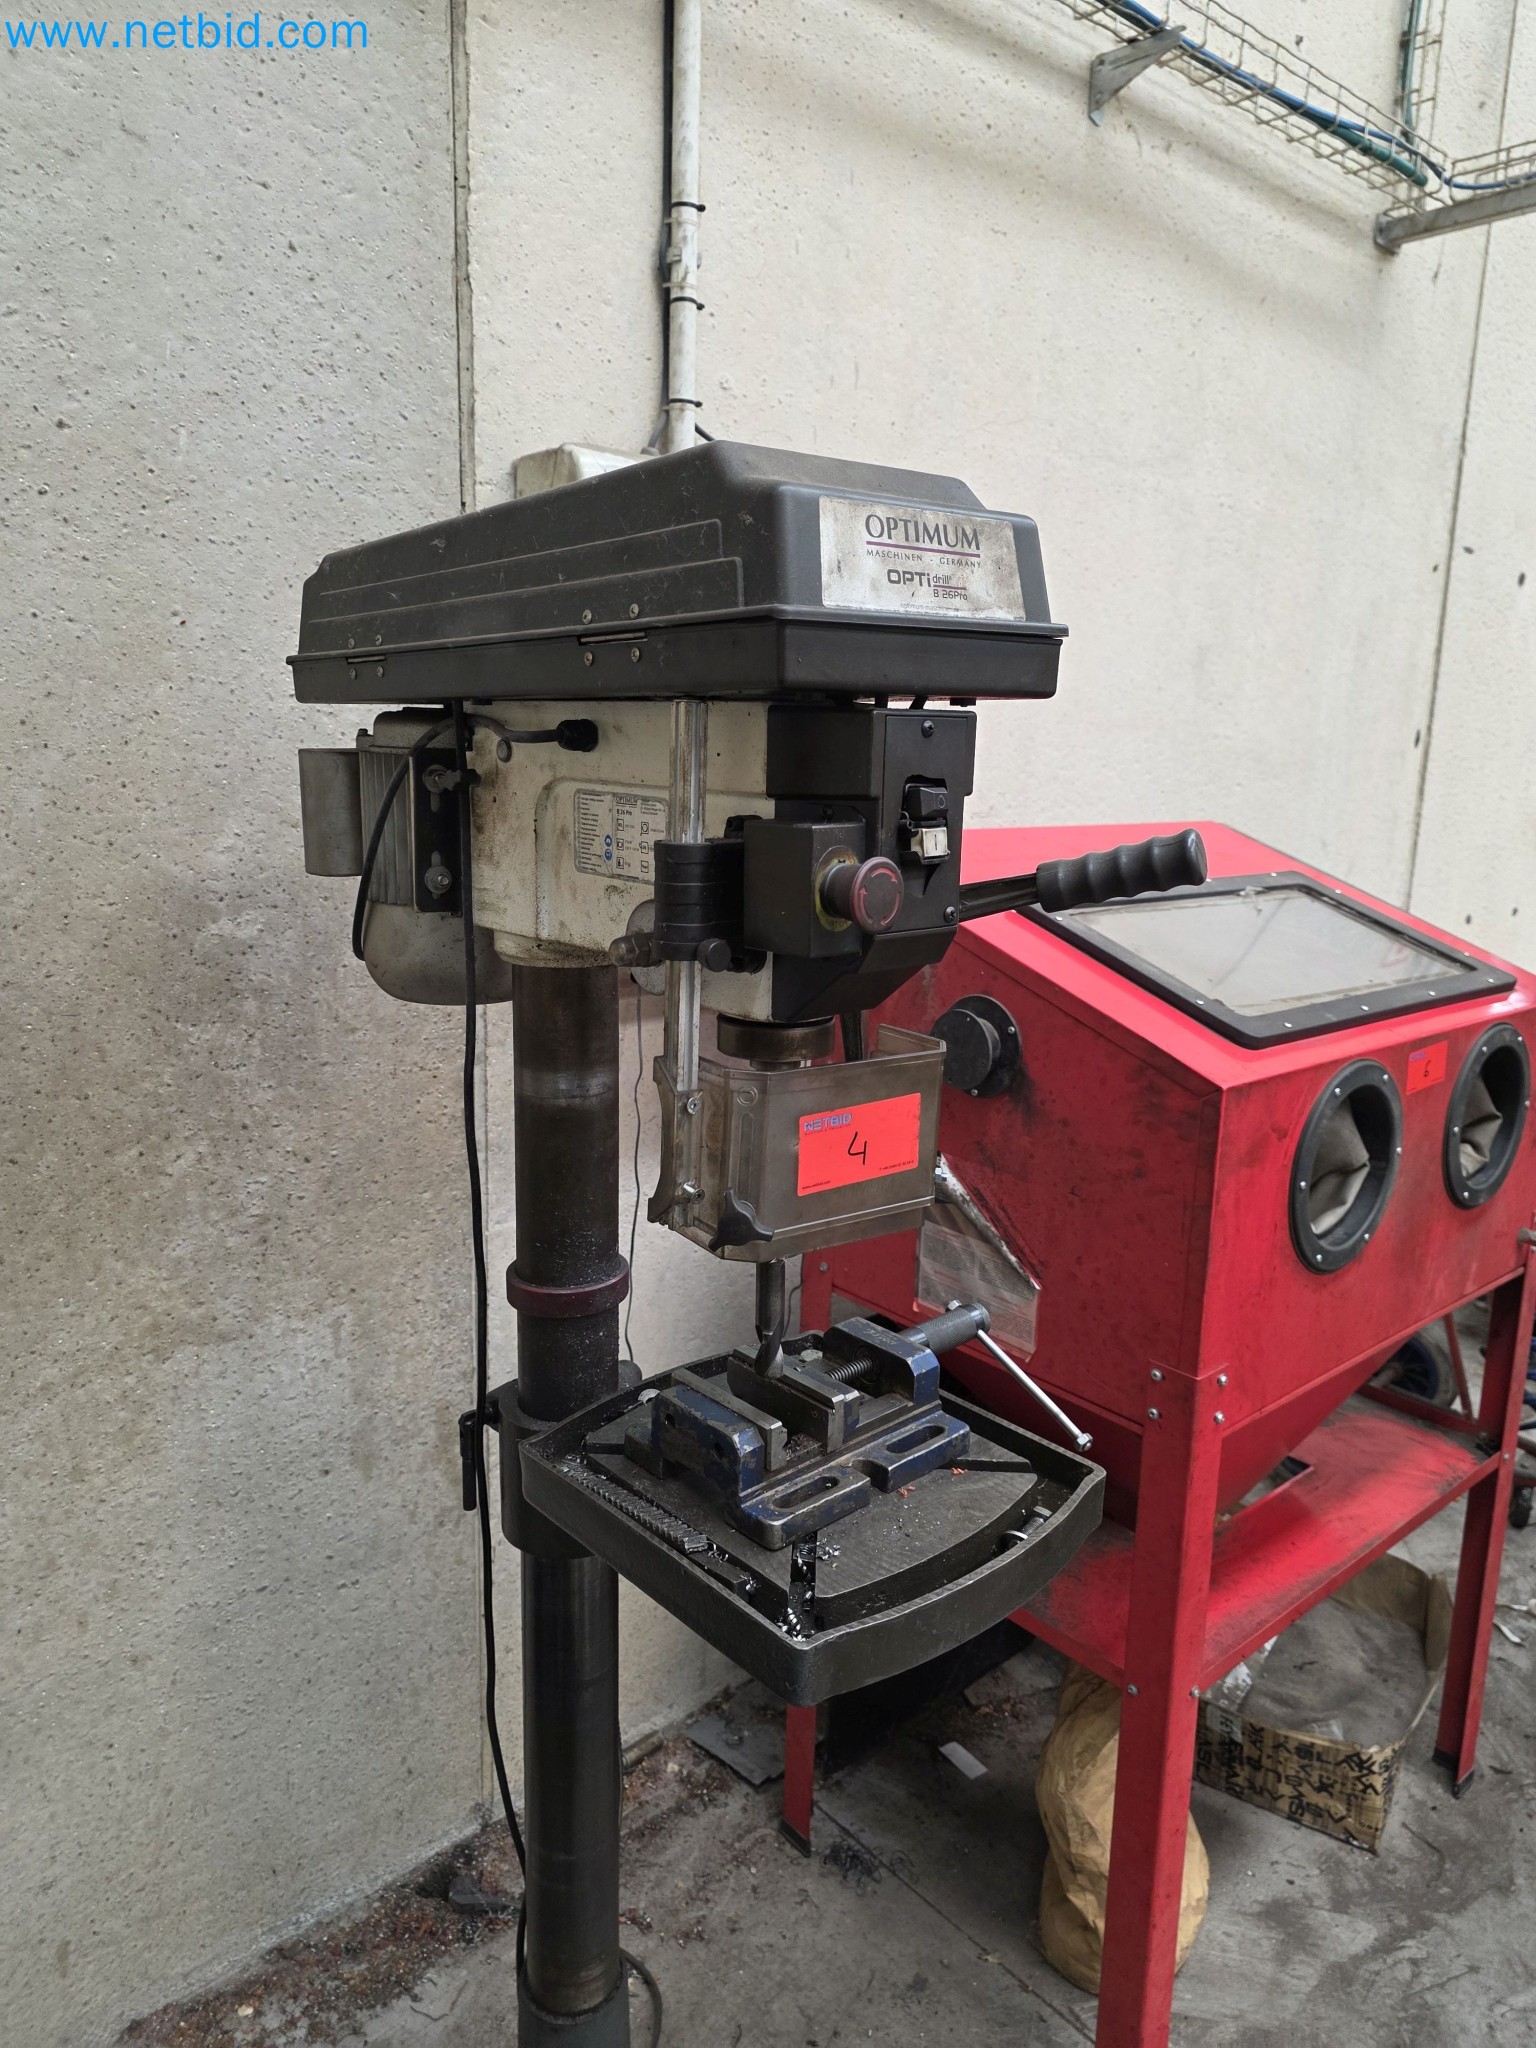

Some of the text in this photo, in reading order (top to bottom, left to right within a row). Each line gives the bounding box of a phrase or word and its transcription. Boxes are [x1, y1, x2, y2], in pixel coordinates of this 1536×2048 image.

[865, 514, 981, 551] OPTIMUM
[866, 548, 923, 562] MASCHINEN
[939, 556, 982, 568] GERMANY
[933, 588, 939, 598] B
[803, 1113, 852, 1132] NETBID
[847, 1131, 867, 1165] 4
